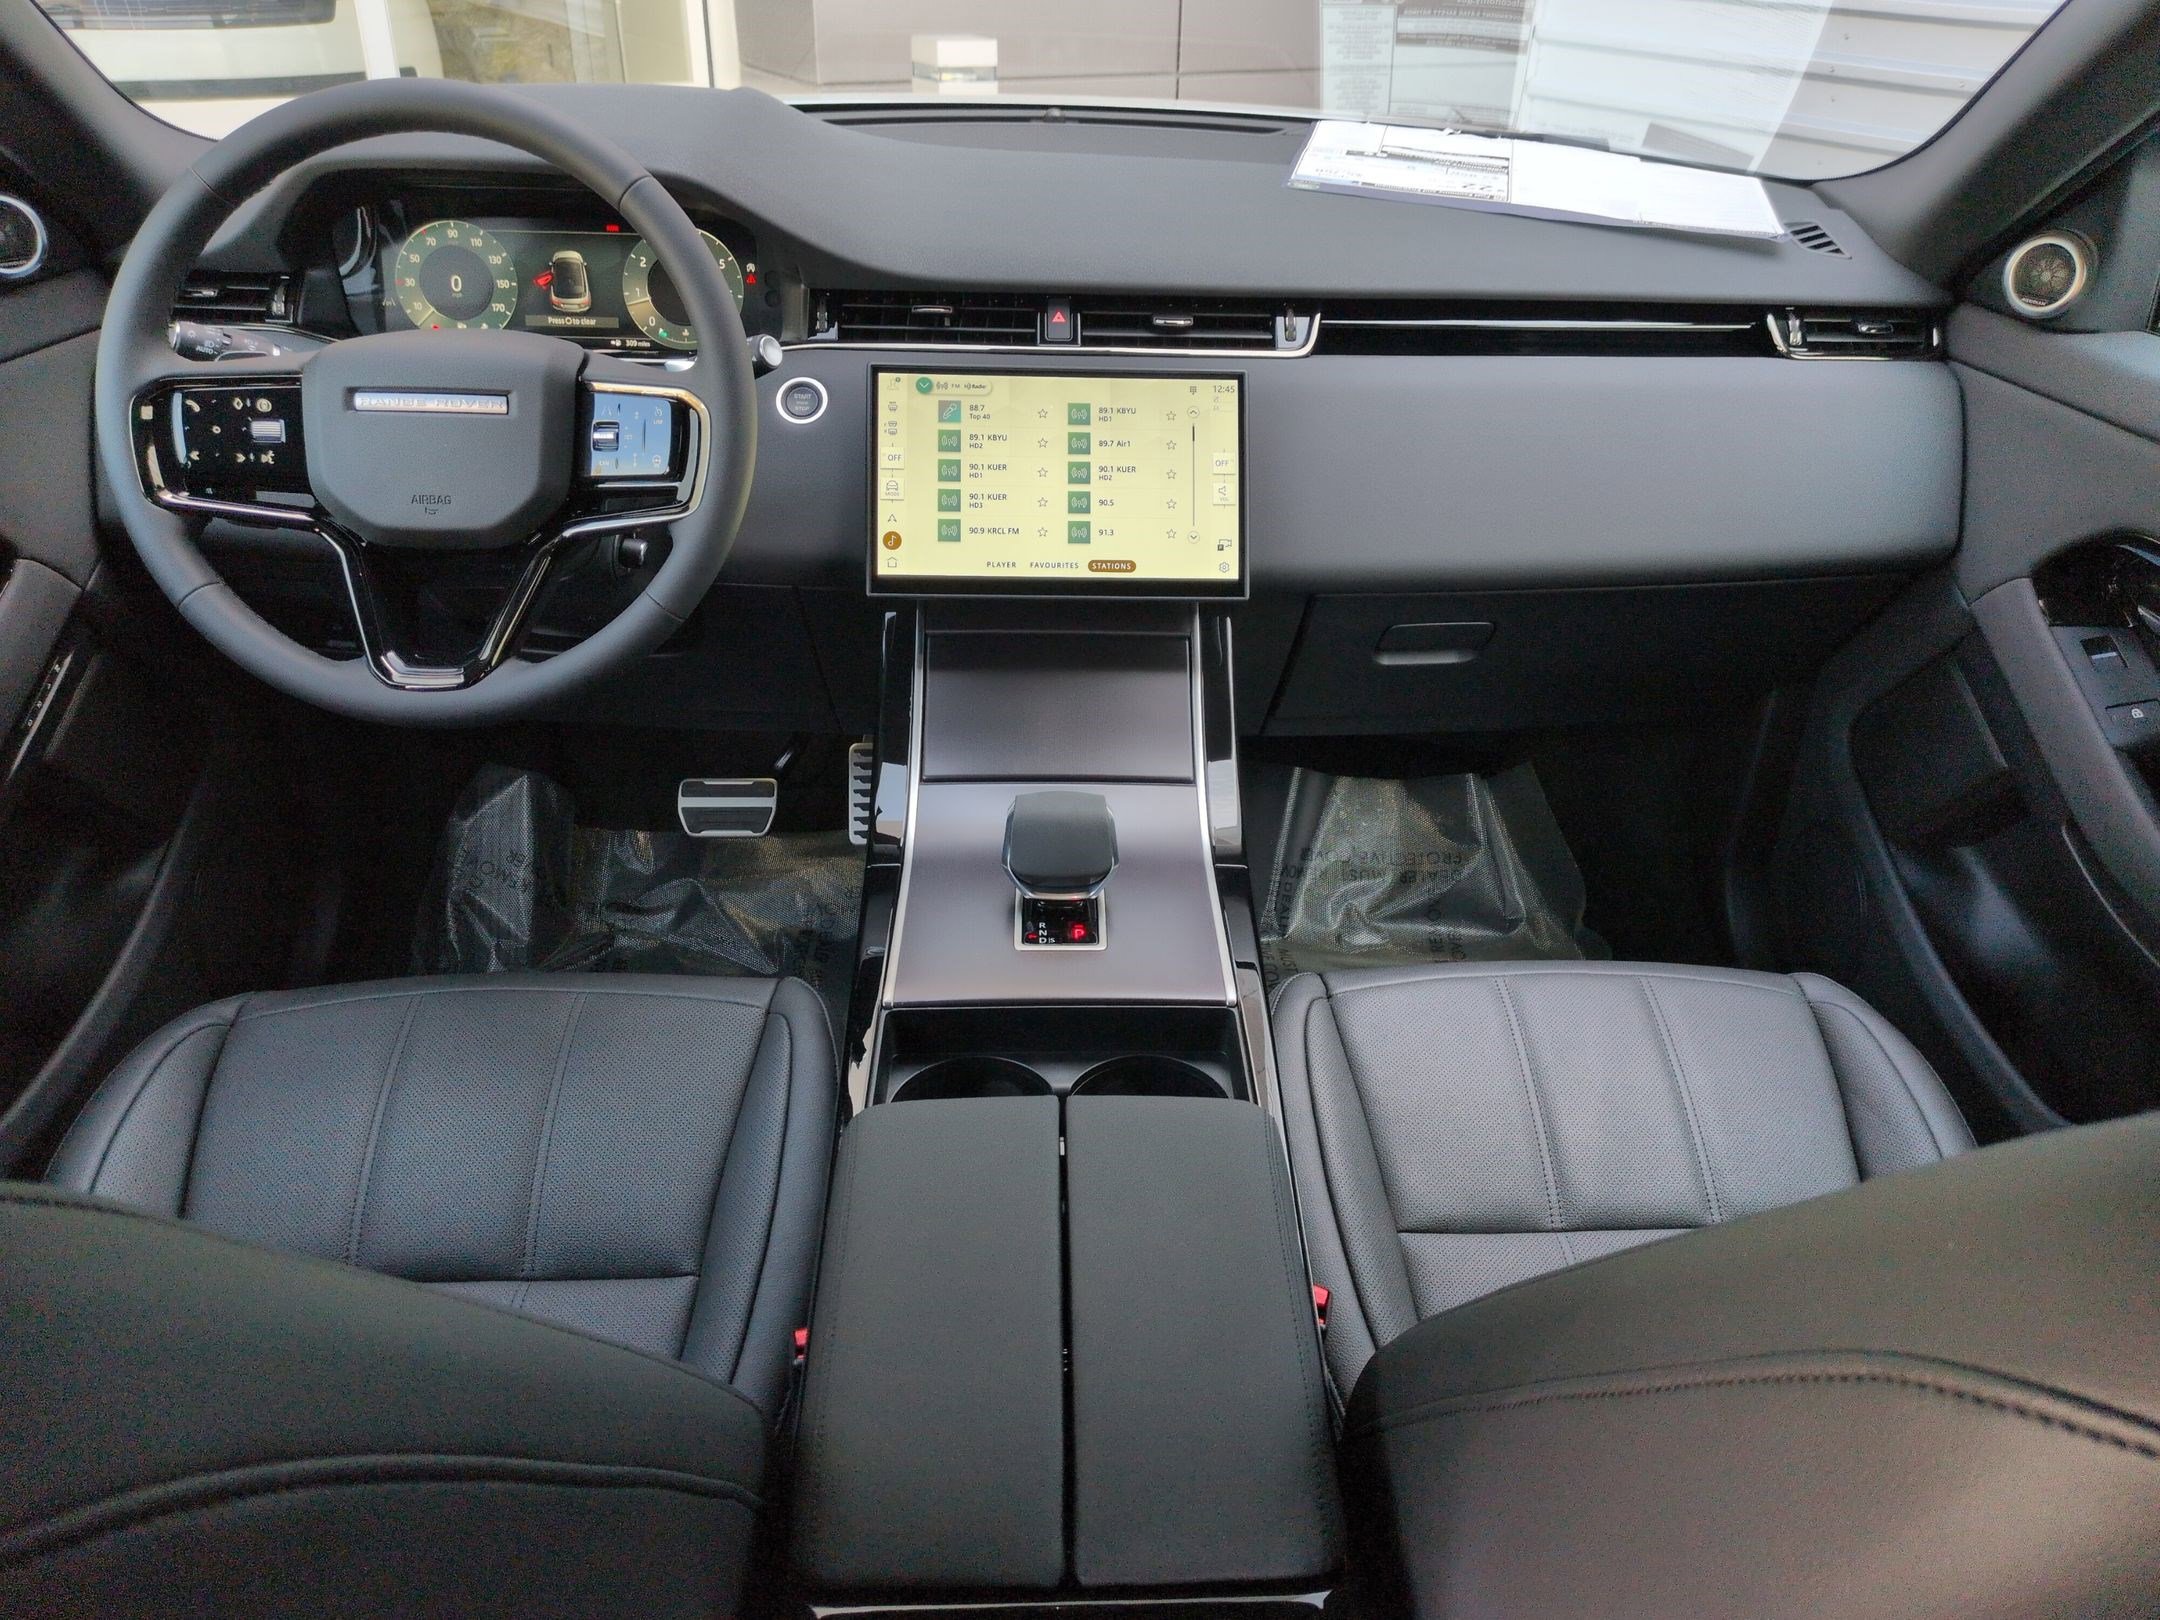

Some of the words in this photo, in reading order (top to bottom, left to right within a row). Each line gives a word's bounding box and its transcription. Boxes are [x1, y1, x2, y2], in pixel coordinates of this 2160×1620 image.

[447, 230, 458, 238] 90
[426, 238, 437, 246] 70
[470, 238, 483, 247] 110
[410, 254, 420, 263] 50
[488, 255, 502, 265] 130
[639, 256, 647, 268] 2
[718, 259, 726, 270] 5
[405, 278, 416, 287] 30
[450, 275, 462, 292] 0
[496, 280, 510, 289] 150
[413, 302, 423, 310] 10
[491, 303, 506, 313] 170
[548, 316, 564, 325] Press
[648, 316, 656, 327] 0
[196, 345, 214, 355] AUTO
[1212, 385, 1236, 394] 12:45
[360, 397, 428, 408] RANGE
[436, 399, 505, 409] ROVER
[969, 404, 985, 412] 88.7
[969, 413, 981, 421] Top
[987, 434, 1008, 442] KBYU
[411, 495, 452, 505] AIRBAG
[969, 527, 985, 535] 90.9
[987, 527, 1006, 535] KRCL
[1074, 929, 1085, 940] P
